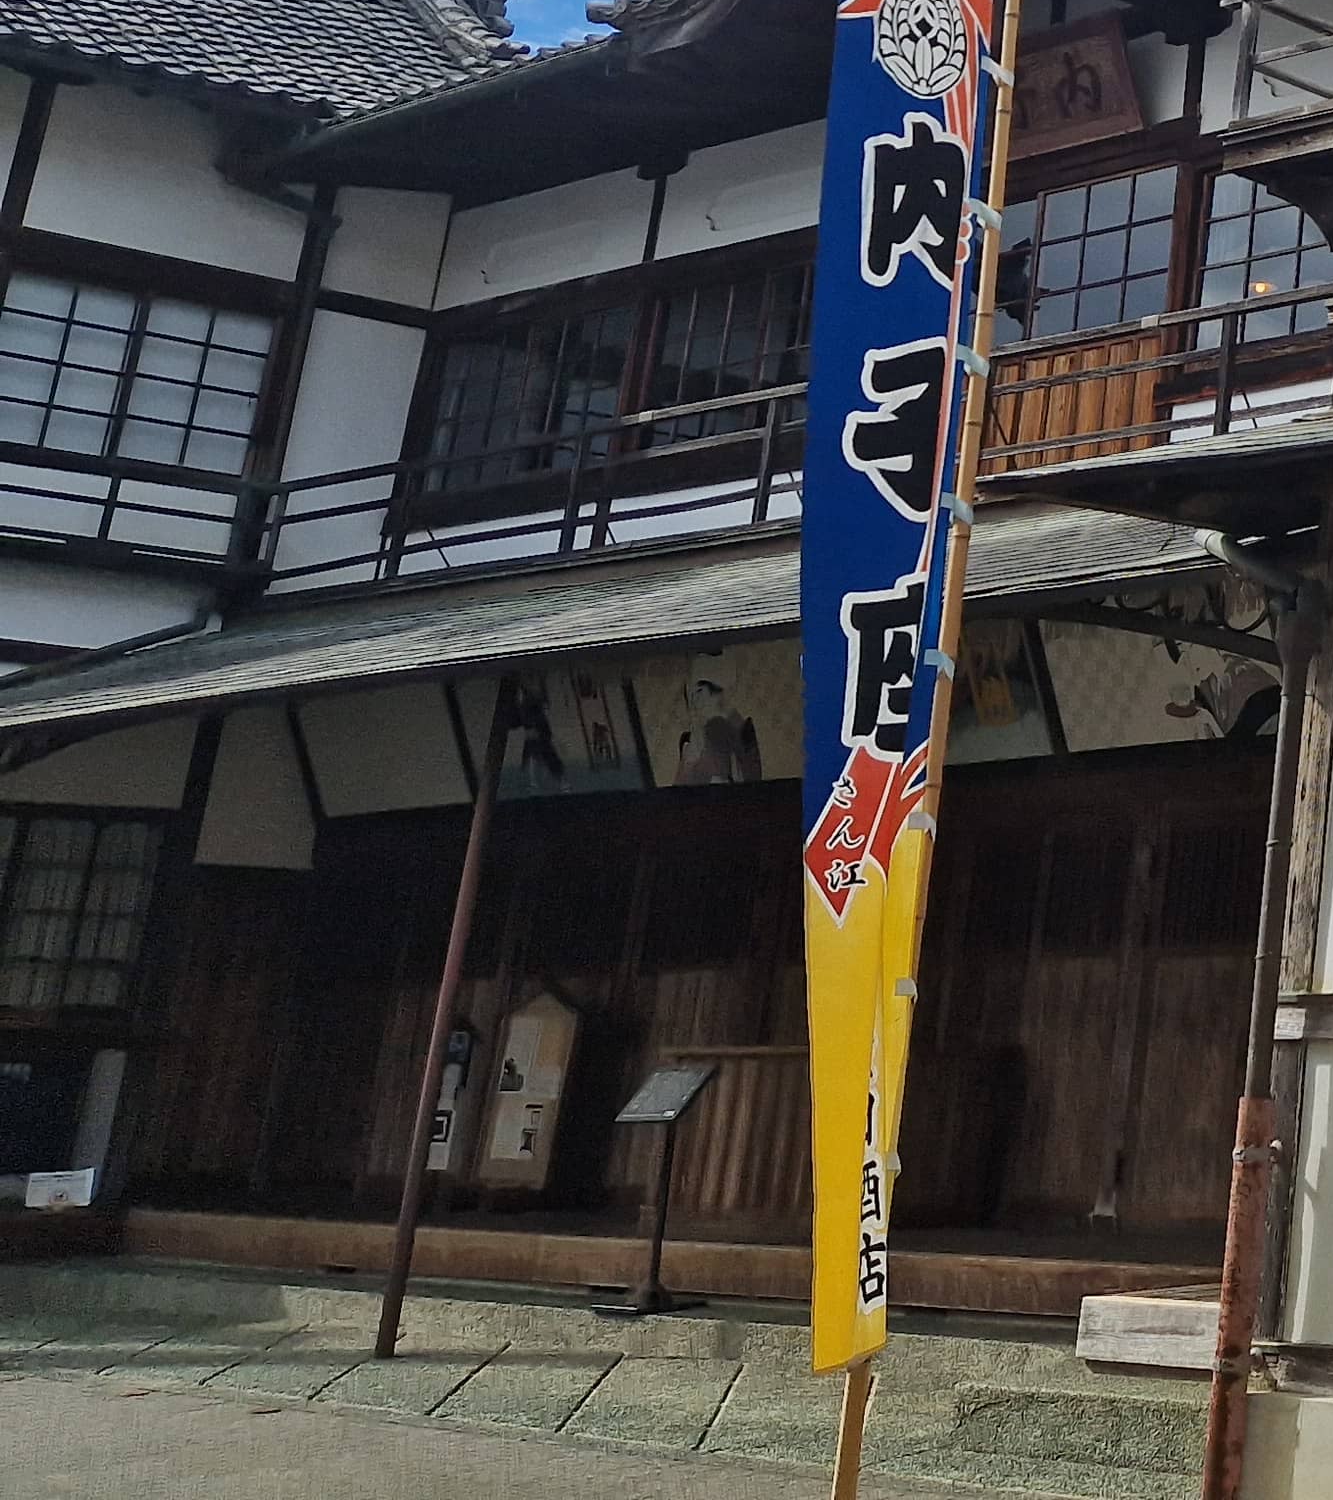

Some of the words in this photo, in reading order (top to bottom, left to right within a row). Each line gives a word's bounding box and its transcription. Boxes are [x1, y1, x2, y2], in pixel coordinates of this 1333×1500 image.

[852, 120, 966, 754] 内子座
[825, 776, 866, 891] さん江
